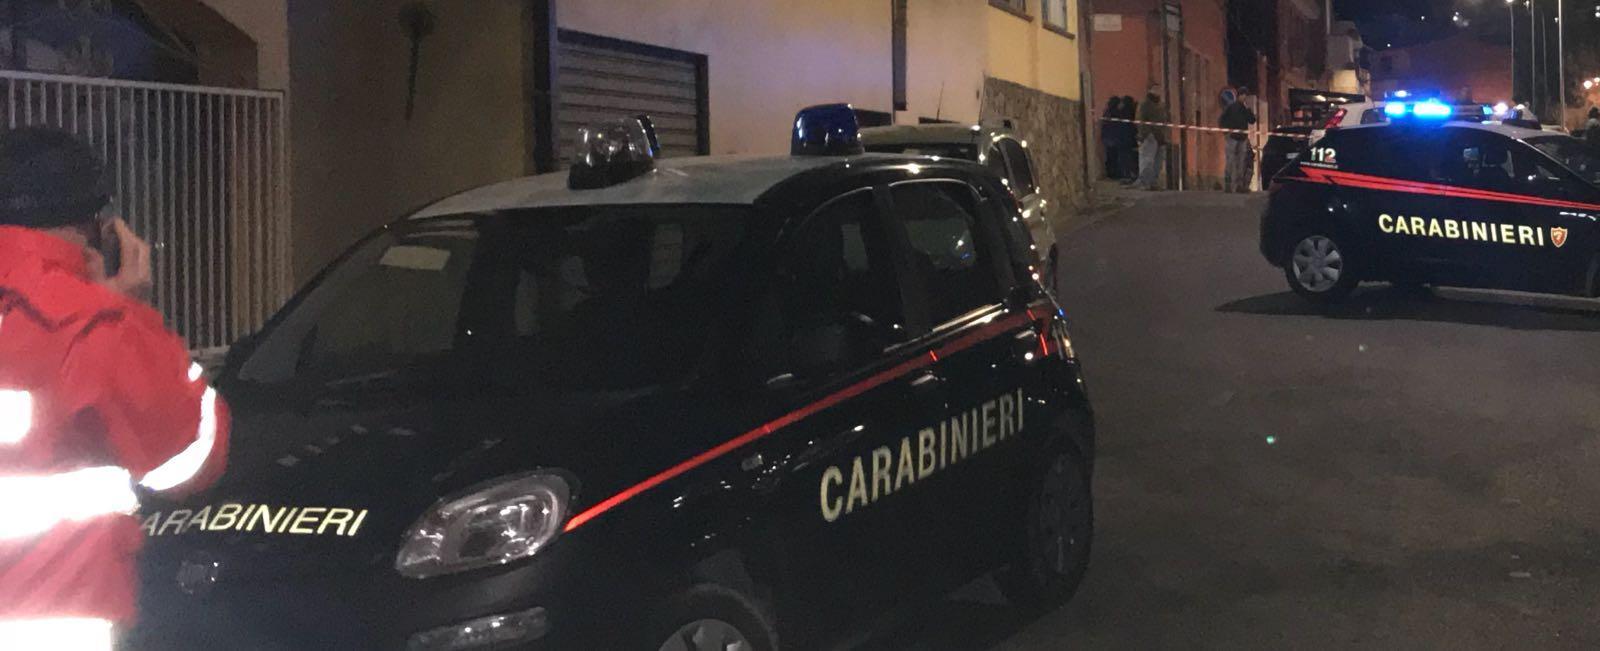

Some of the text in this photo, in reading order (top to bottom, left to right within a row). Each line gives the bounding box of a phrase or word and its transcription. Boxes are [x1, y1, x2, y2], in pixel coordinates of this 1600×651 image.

[1310, 147, 1337, 163] 112
[1378, 213, 1545, 246] CARABINIERI
[820, 387, 1024, 523] CARABINIERI
[138, 503, 368, 536] ARABINIERI
